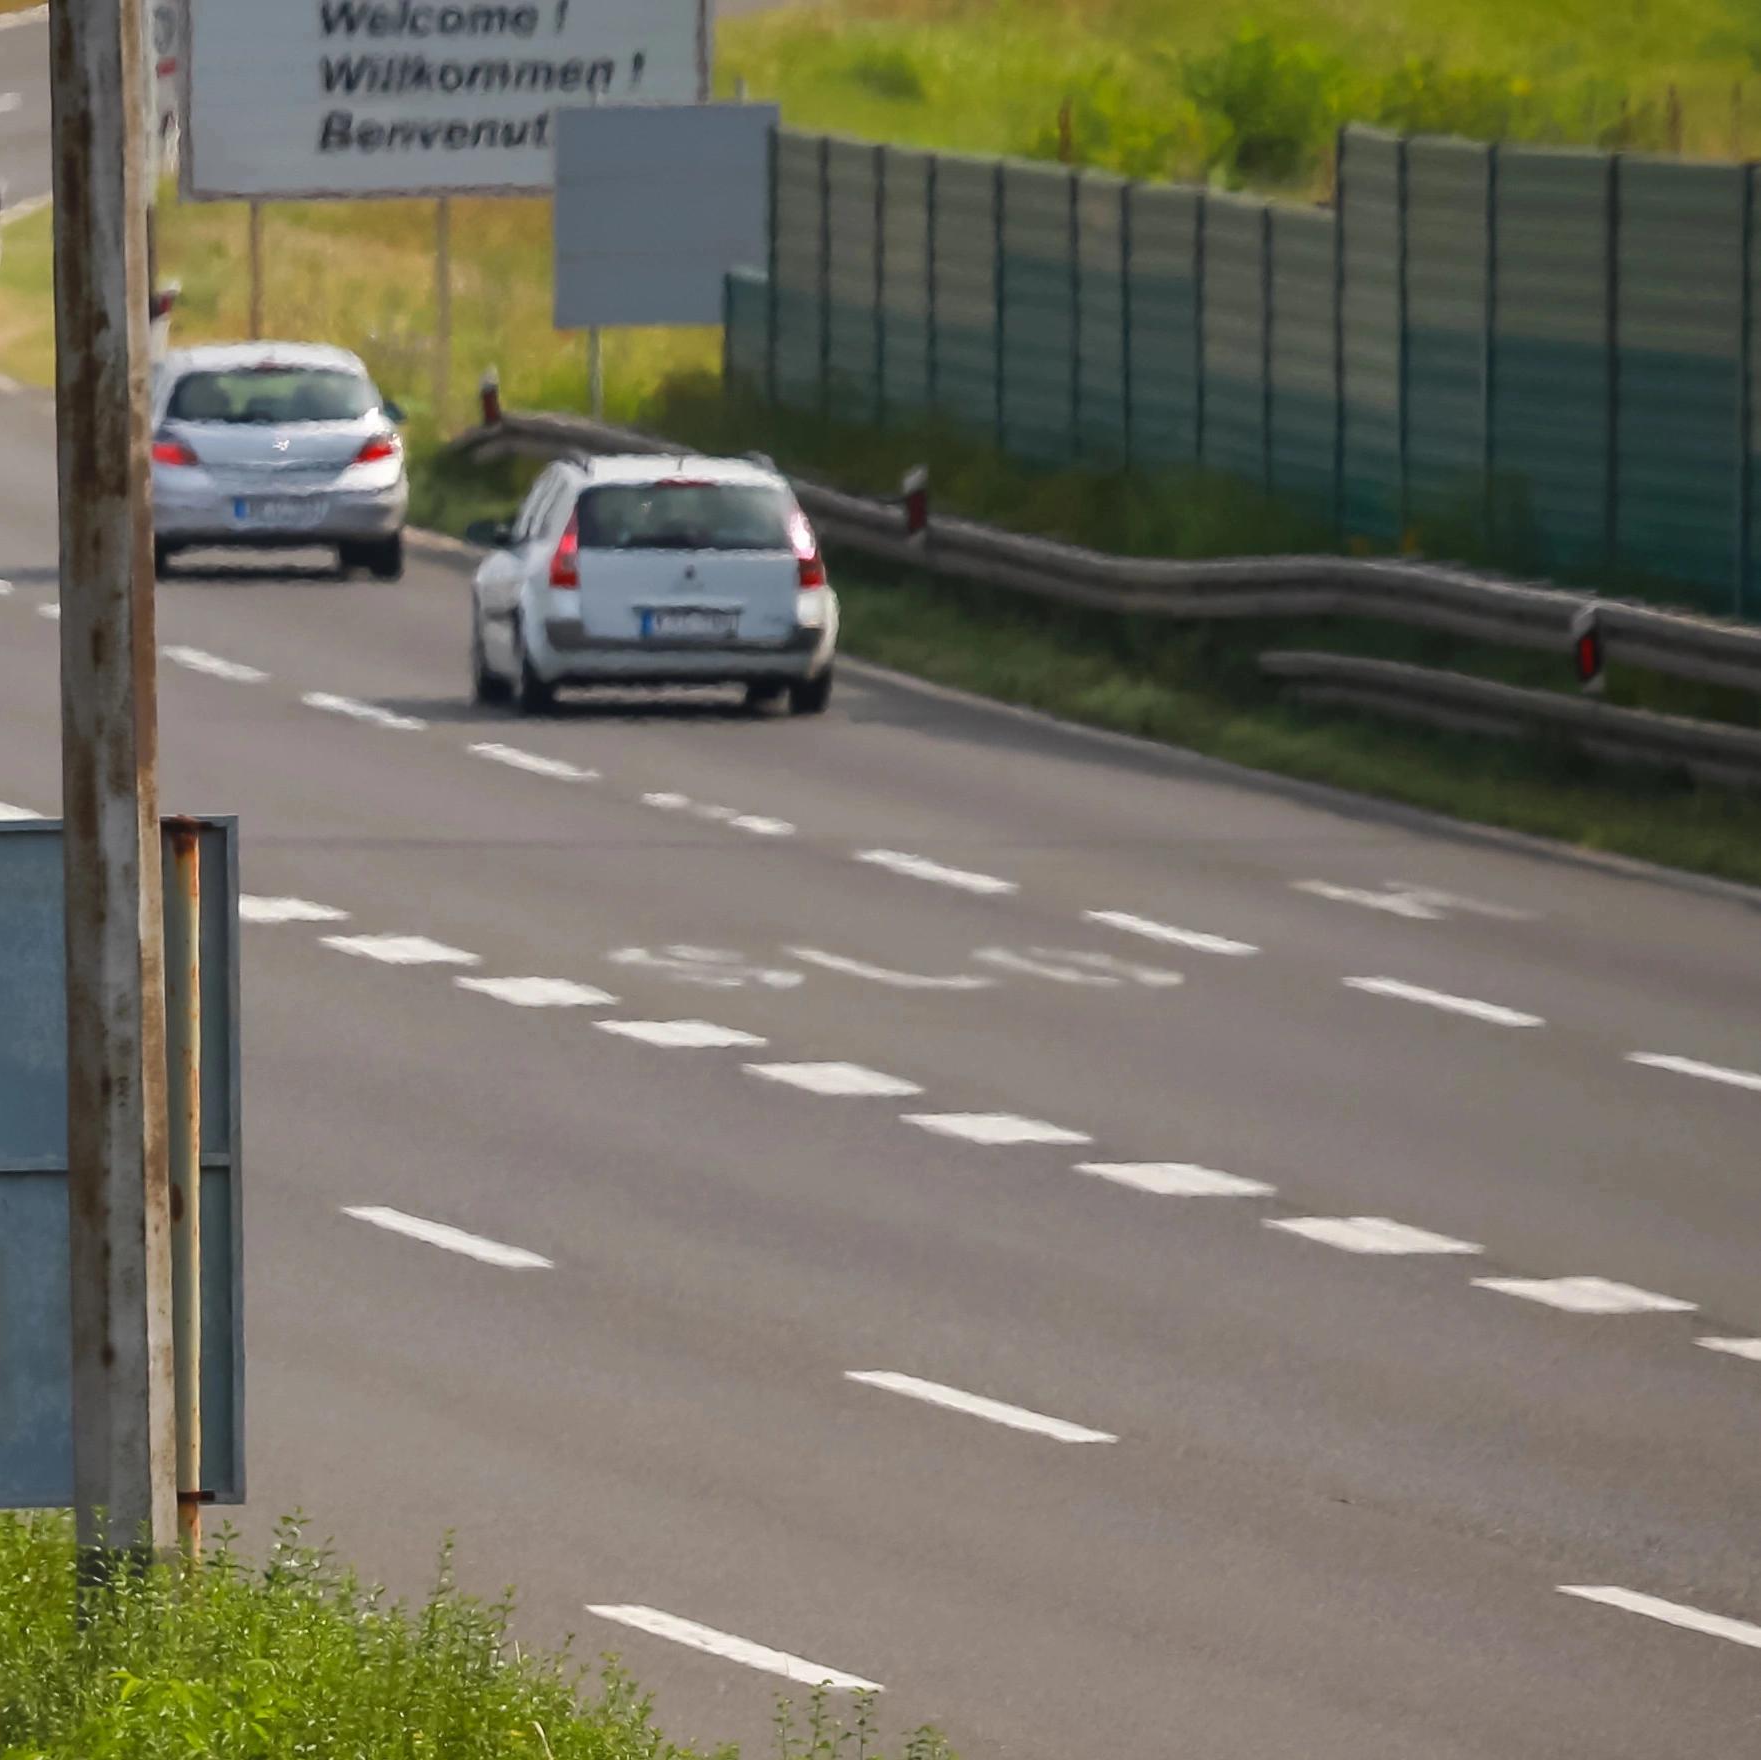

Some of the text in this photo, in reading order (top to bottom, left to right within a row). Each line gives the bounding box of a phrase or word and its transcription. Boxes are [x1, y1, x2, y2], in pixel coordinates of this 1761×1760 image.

[321, 0, 538, 37] Welcome
[320, 54, 614, 93] Willkommen
[319, 110, 549, 149] Benvenut
